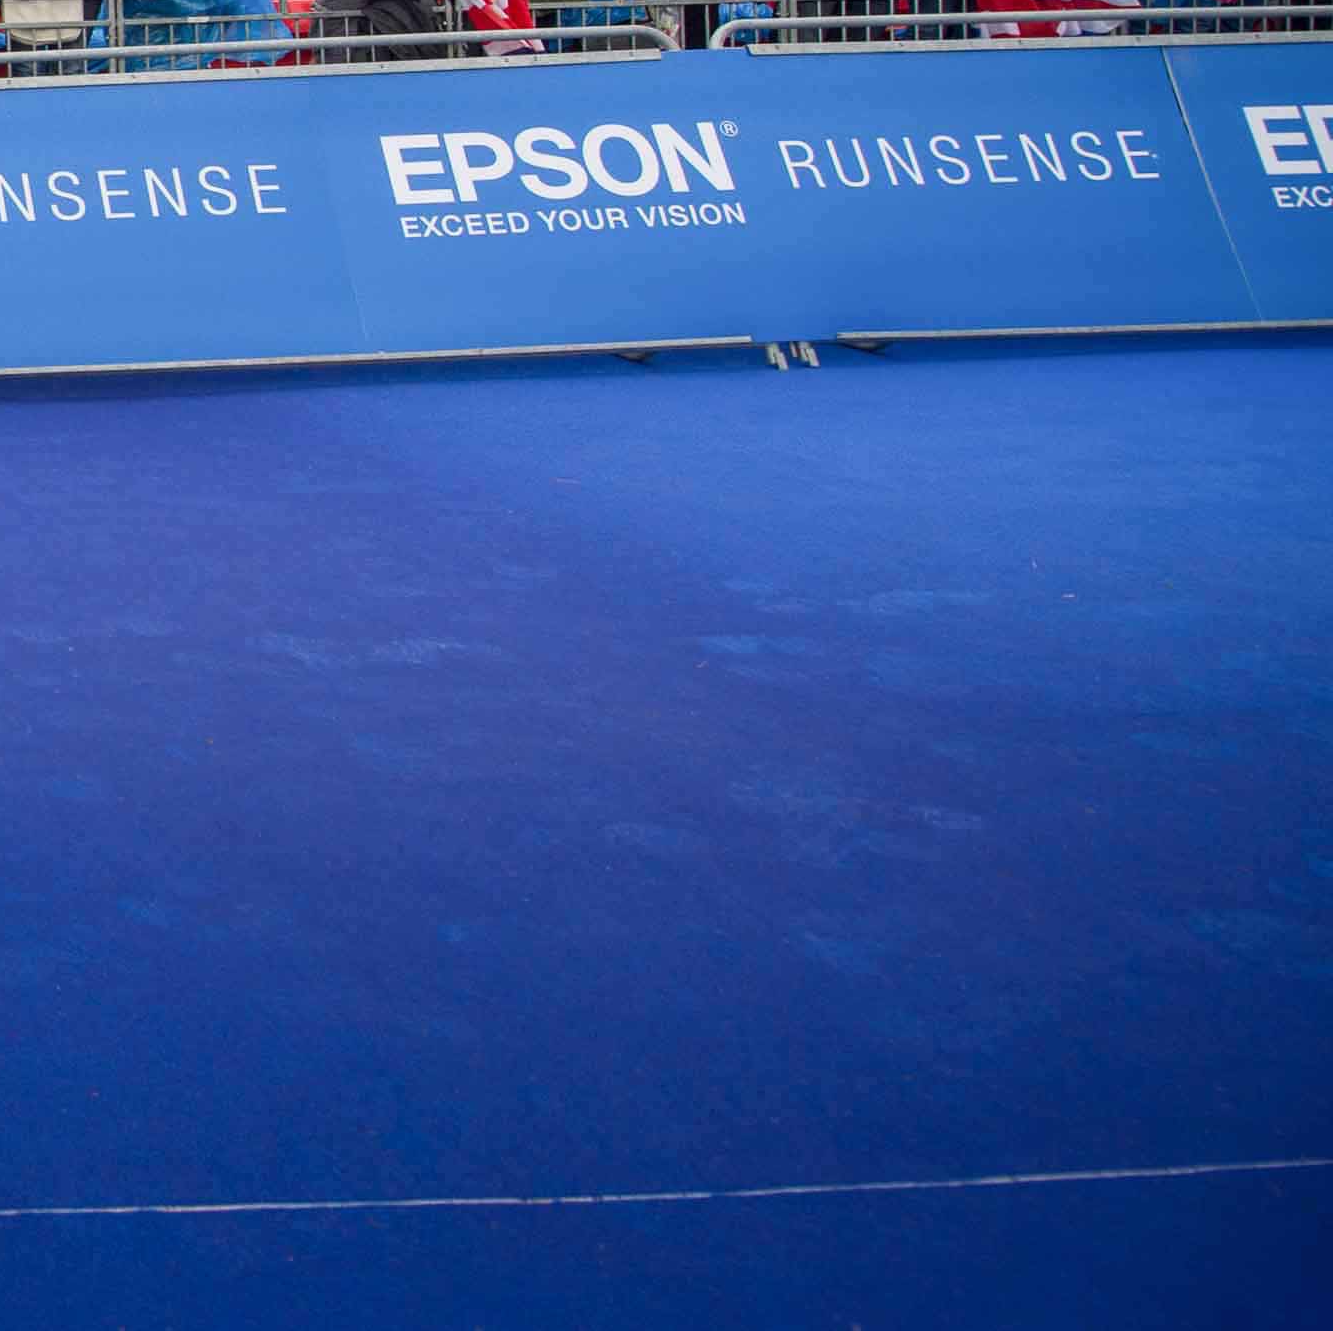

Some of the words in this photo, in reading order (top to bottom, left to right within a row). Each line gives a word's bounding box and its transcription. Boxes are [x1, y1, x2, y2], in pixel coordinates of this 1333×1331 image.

[777, 130, 1161, 190] RUNSENSE
[400, 212, 530, 238] EXCEED
[536, 208, 630, 232] YOUR
[636, 202, 746, 228] VISION
